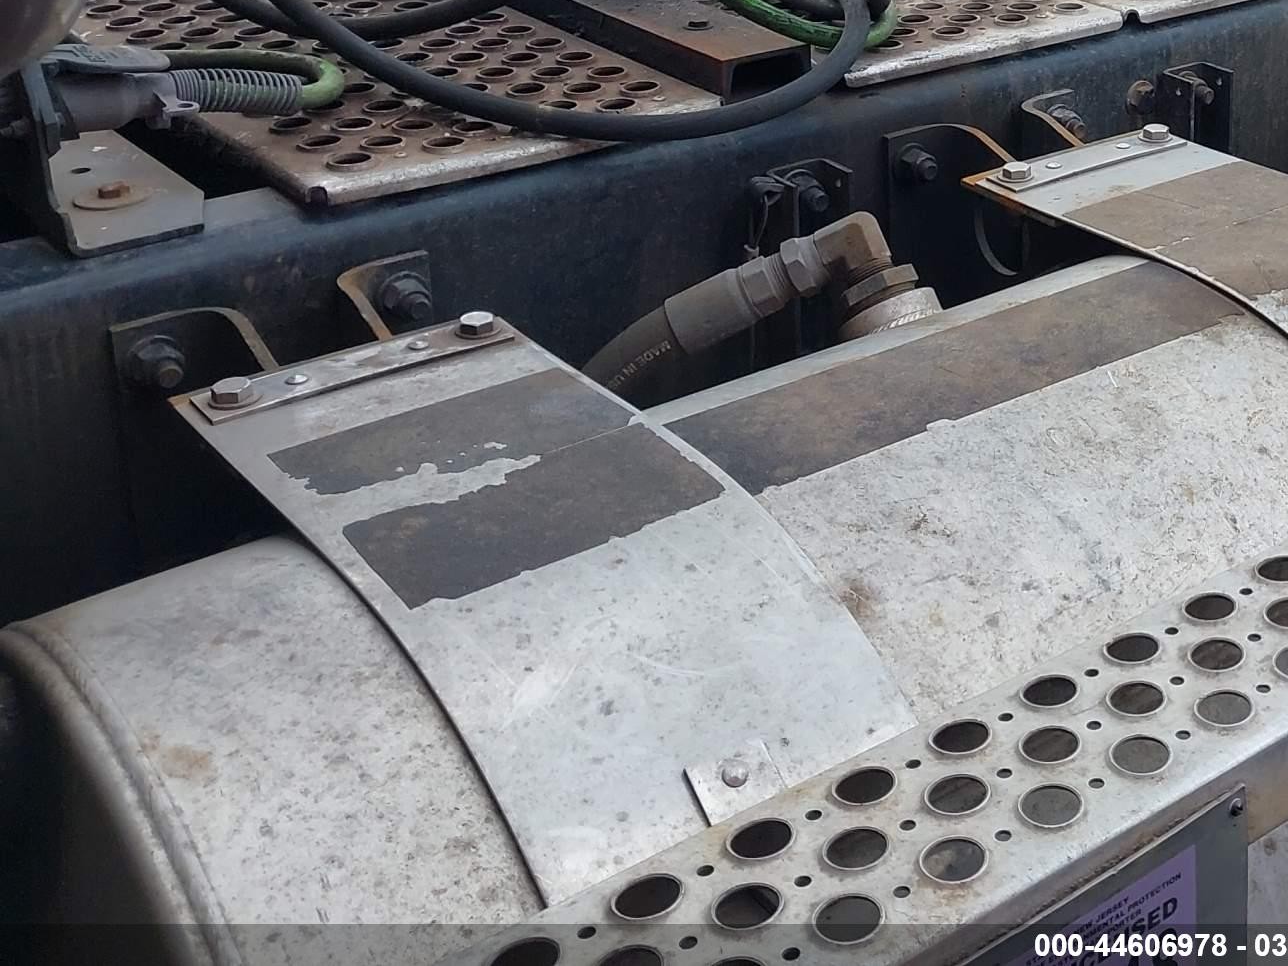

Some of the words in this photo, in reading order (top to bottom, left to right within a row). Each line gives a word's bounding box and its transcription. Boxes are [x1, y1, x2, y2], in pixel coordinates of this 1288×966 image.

[634, 340, 672, 366] MADE
[621, 362, 638, 377] IN
[1128, 872, 1182, 912] PROTECTION
[1096, 896, 1129, 923] JERSEY
